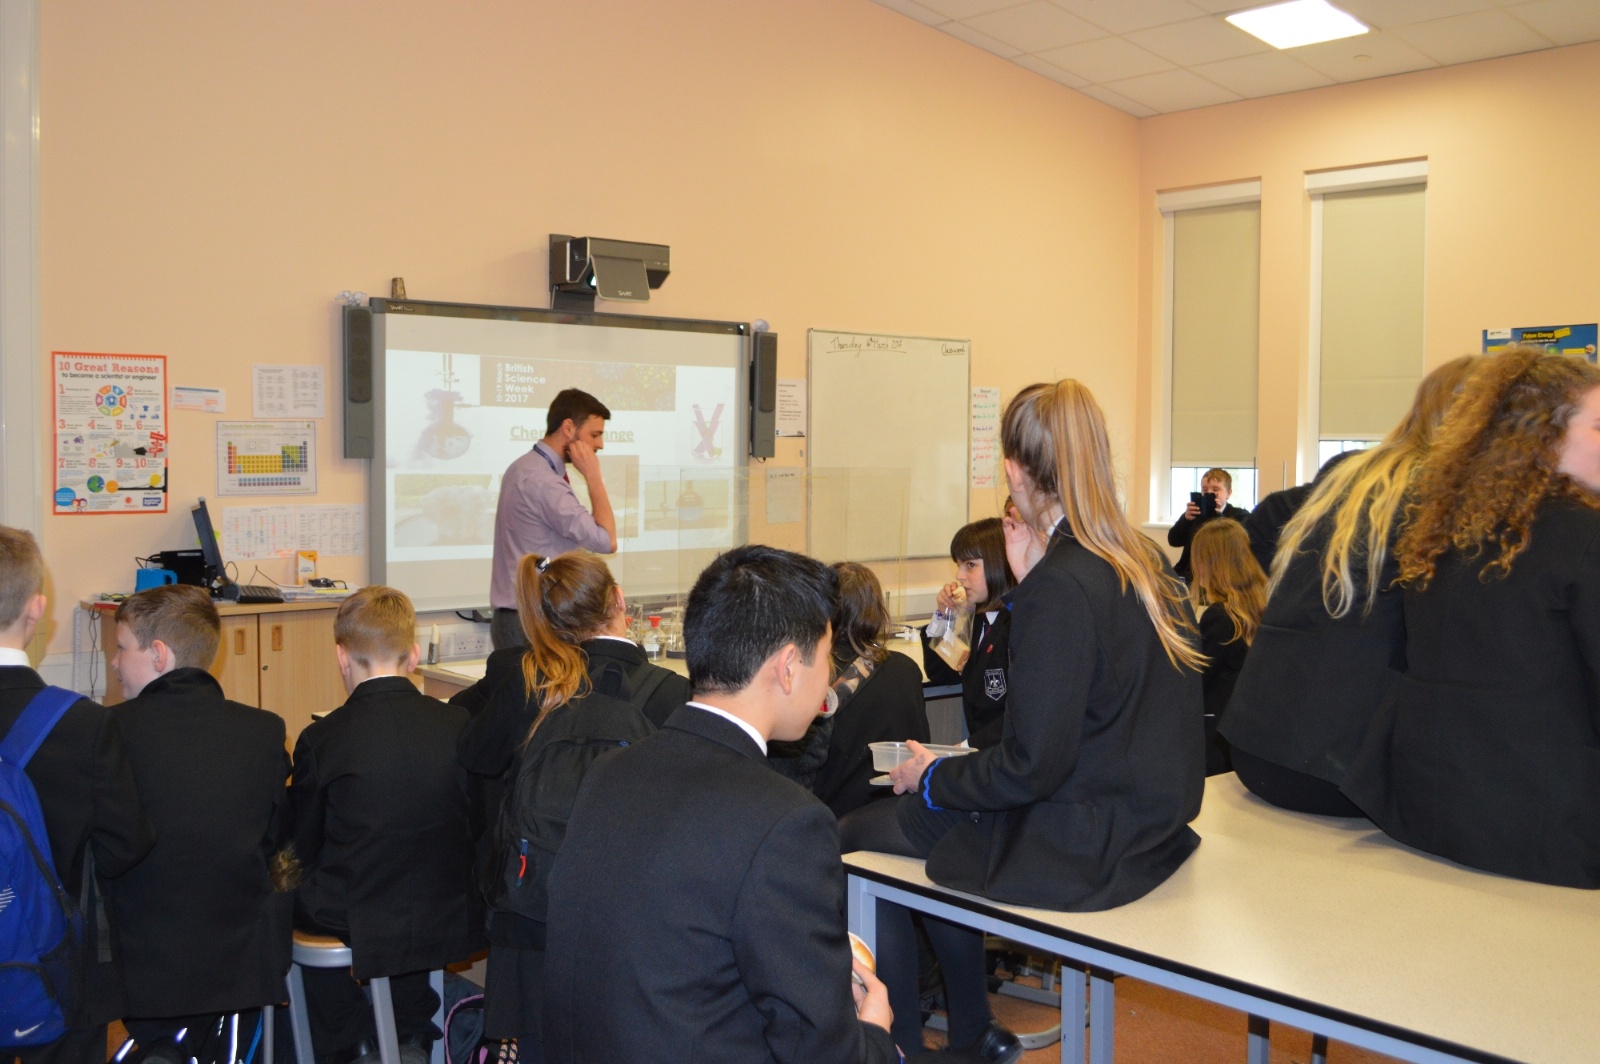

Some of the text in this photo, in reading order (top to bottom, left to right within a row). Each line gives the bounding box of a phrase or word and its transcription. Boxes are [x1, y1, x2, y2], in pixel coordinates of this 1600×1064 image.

[59, 361, 159, 374] 10 Great Reasons
[505, 363, 534, 373] British
[505, 374, 546, 384] Science
[59, 384, 65, 394] 1
[126, 386, 134, 396] 2
[505, 384, 535, 393] Week
[505, 394, 529, 402] 2017
[60, 419, 67, 429] 3
[88, 420, 96, 430] 4
[116, 420, 123, 430] 5
[136, 420, 143, 430] 6
[59, 458, 66, 468] 7
[89, 458, 96, 468] 8
[116, 458, 123, 468] 9
[135, 459, 147, 469] 10
